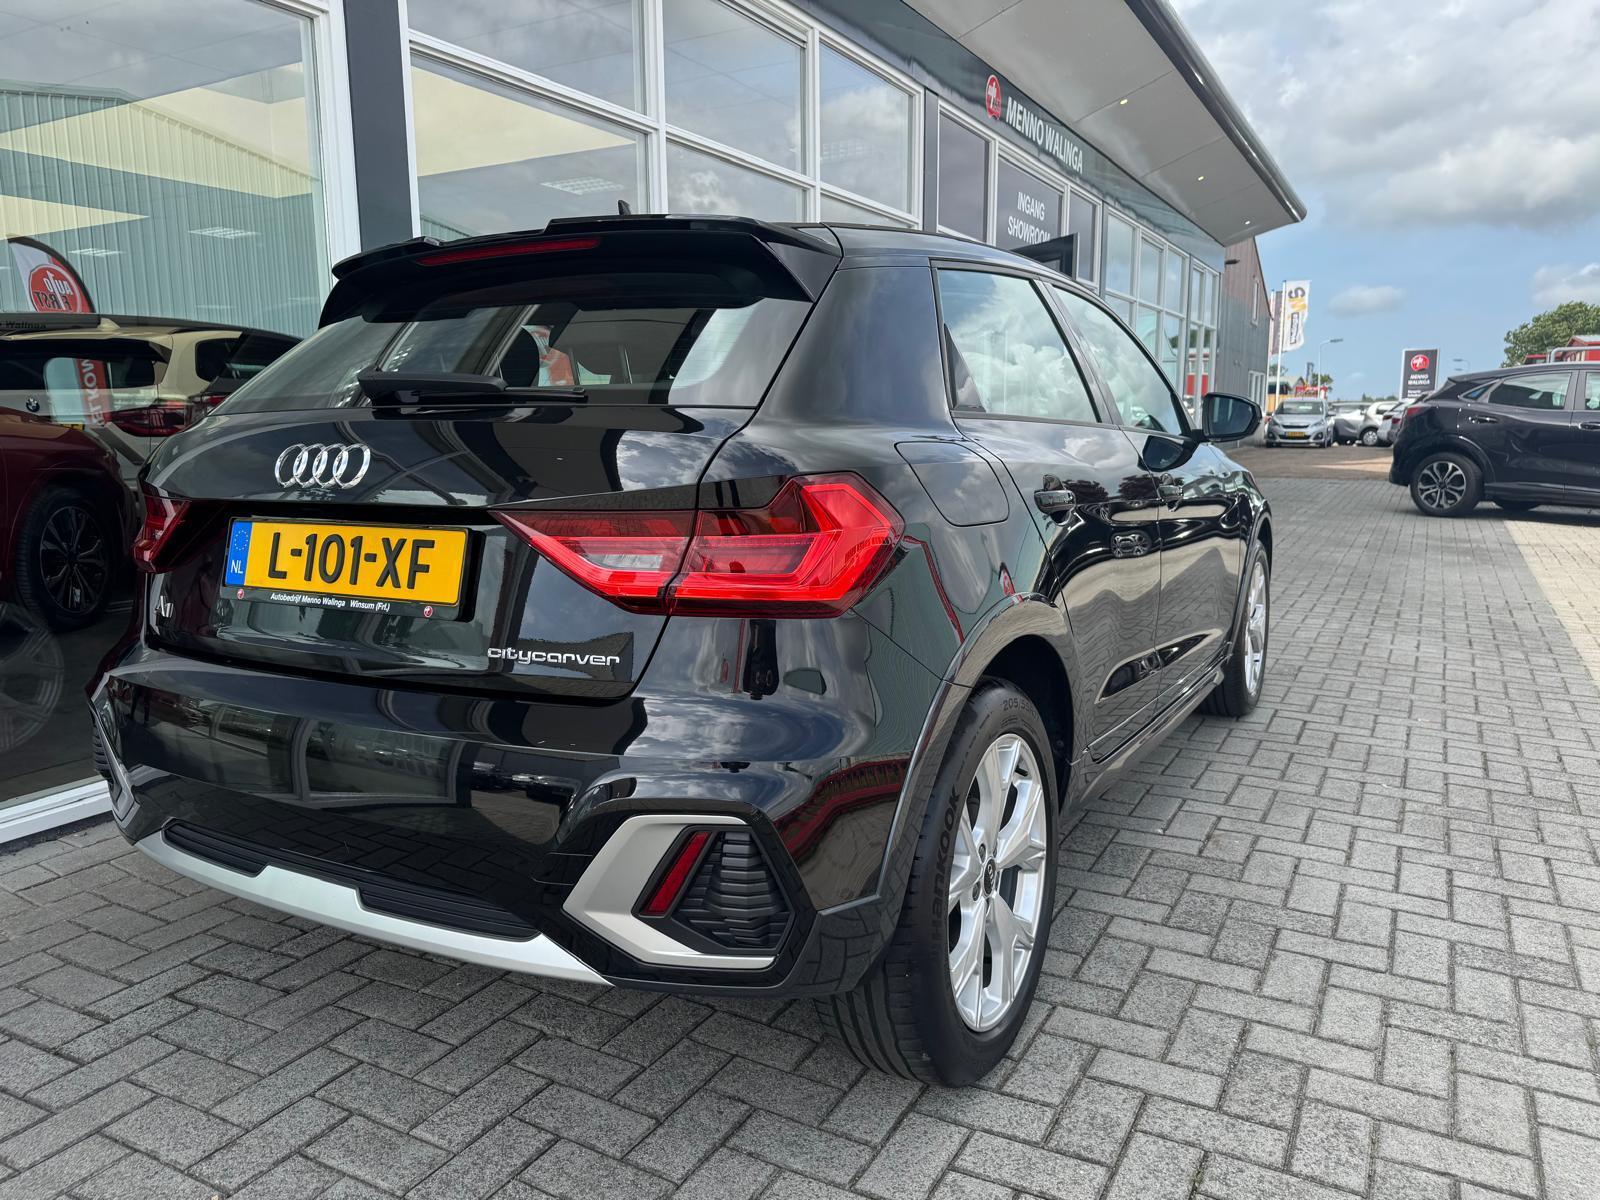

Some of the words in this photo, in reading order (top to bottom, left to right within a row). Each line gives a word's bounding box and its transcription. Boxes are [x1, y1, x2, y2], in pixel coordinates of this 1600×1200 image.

[1005, 96, 1044, 146] MENNO
[1045, 124, 1083, 174] WALINGA
[1017, 191, 1045, 221] INGANG
[230, 559, 243, 574] NL
[267, 531, 436, 590] L-101-XF
[270, 592, 302, 604] Autobedrijf
[302, 595, 321, 605] Menno
[322, 597, 346, 608] Walinga
[350, 599, 375, 610] Winsum
[375, 602, 391, 612] (Frl.)
[487, 647, 620, 666] citycarver
